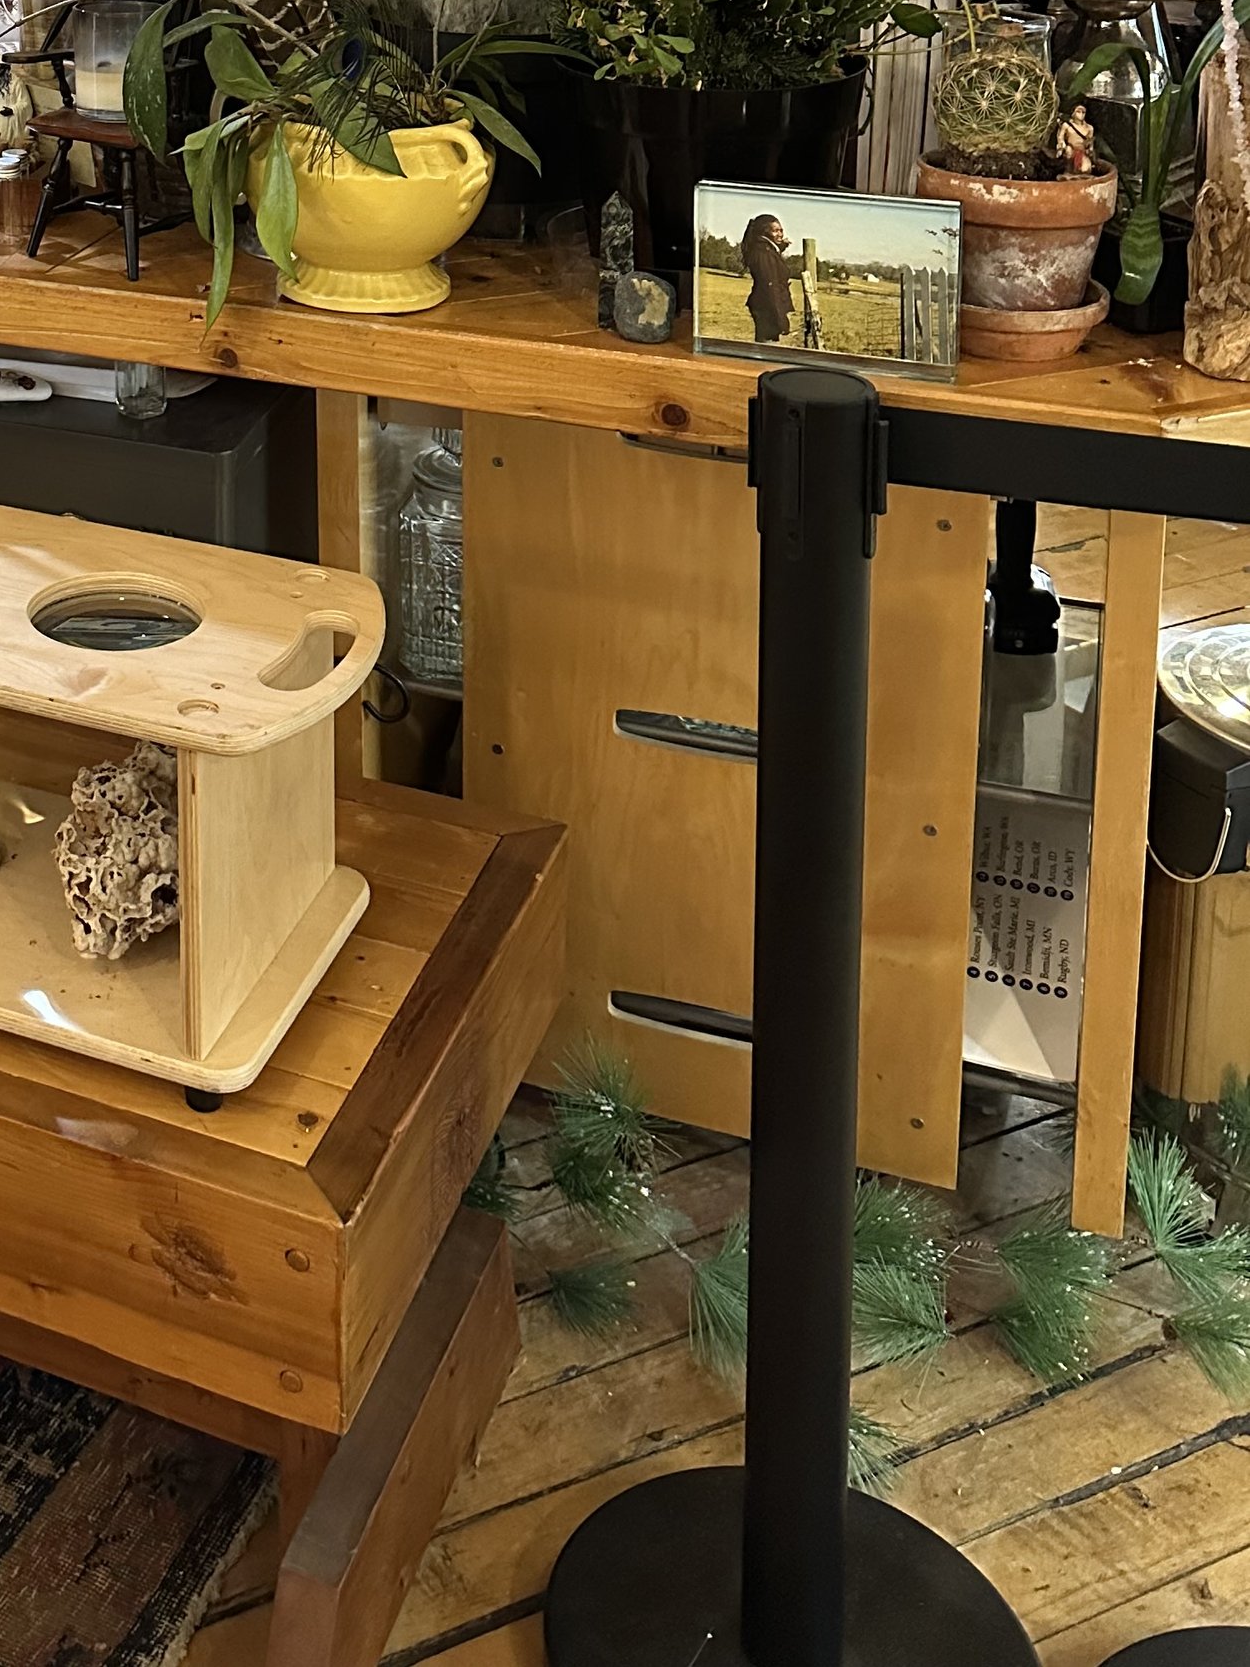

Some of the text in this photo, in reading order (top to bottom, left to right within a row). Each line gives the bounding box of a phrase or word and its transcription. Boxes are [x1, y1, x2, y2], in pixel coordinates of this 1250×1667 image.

[1047, 851, 1057, 862] ID
[1042, 926, 1052, 943] MN
[1059, 939, 1069, 954] ND
